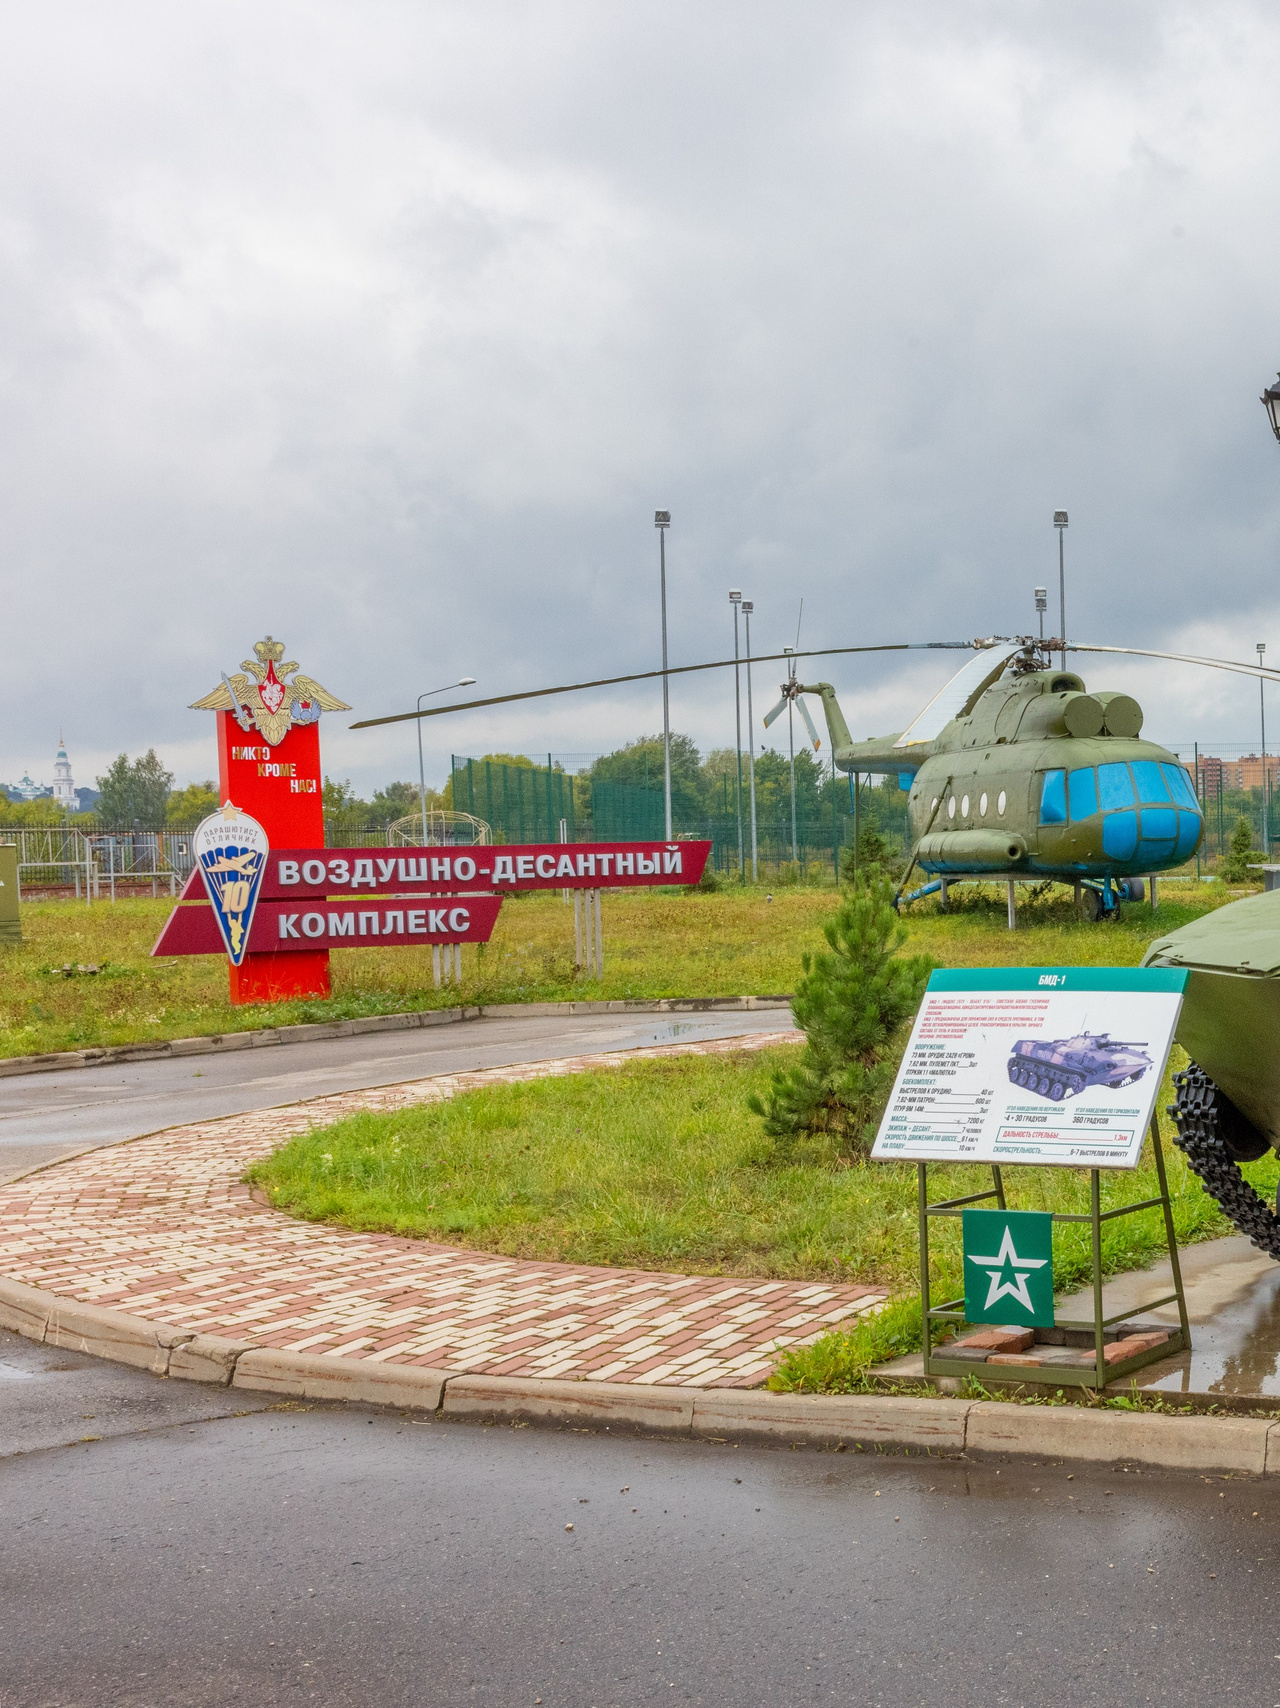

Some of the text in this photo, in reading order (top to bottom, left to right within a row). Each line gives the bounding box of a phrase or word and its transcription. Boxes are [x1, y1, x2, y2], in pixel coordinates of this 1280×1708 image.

[232, 746, 270, 760] НИКТО
[257, 763, 296, 777] КРОМЕ
[290, 779, 317, 793] НАС!
[204, 826, 258, 839] ПАРАШЮТИСТ
[206, 834, 256, 845] ОТЛИЧНИК
[278, 845, 683, 888] ВОЗДУШНО-ДЕСАНТНЫЙ
[221, 880, 251, 913] 10
[278, 908, 470, 939] КОМПЛЕКС
[1038, 975, 1066, 986] БМД-1
